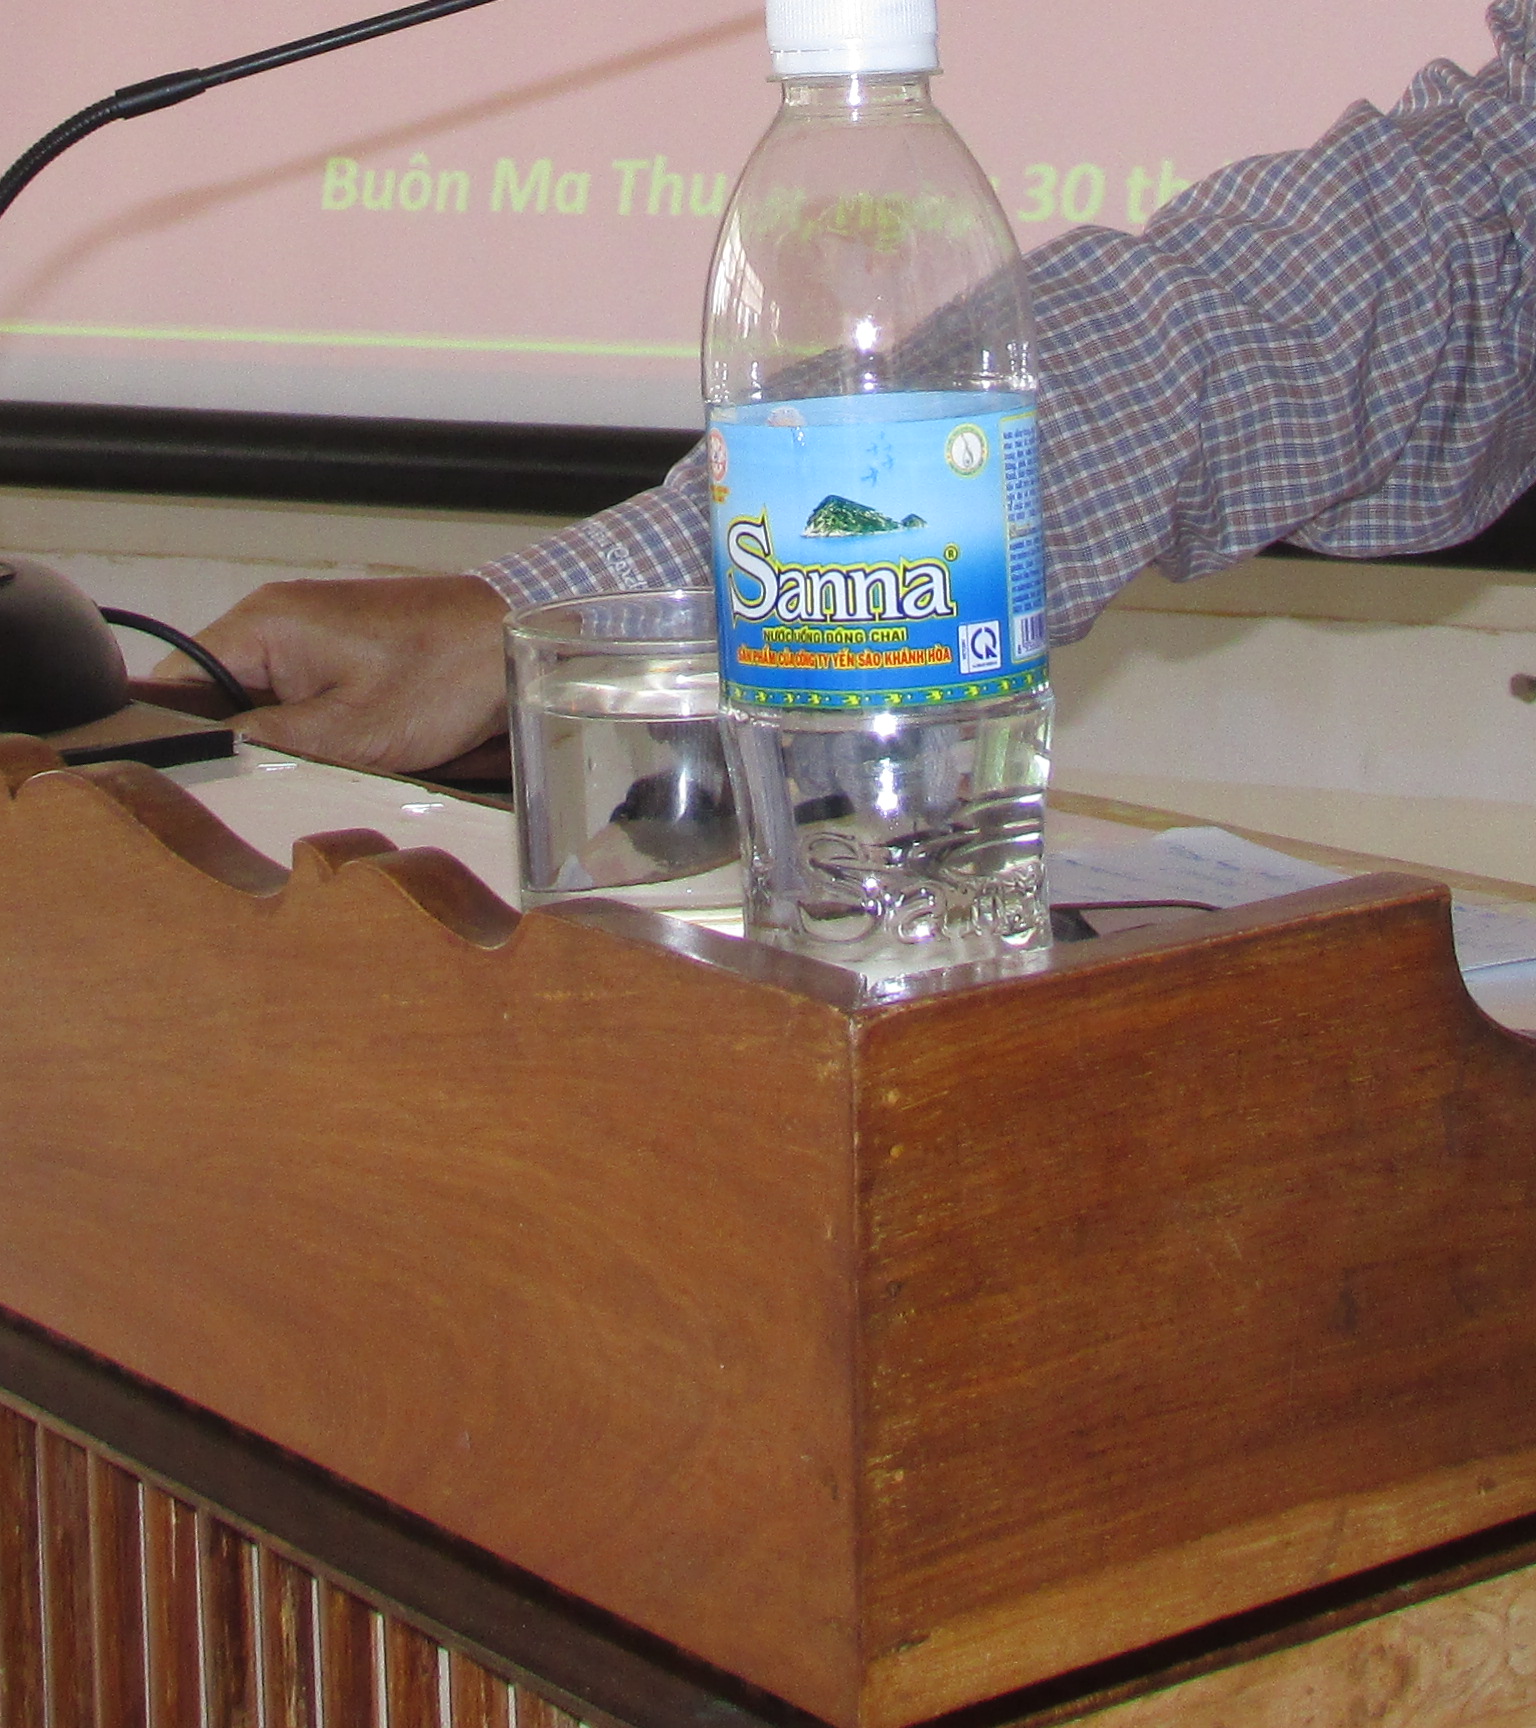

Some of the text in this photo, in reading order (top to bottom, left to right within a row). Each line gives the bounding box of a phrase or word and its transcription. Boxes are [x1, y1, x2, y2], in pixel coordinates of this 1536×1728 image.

[321, 152, 471, 212] Buôn
[490, 157, 591, 214] Ma
[612, 154, 728, 216] Thu
[1016, 161, 1107, 223] 30
[728, 504, 958, 627] Sanna
[869, 627, 907, 643] CHAI
